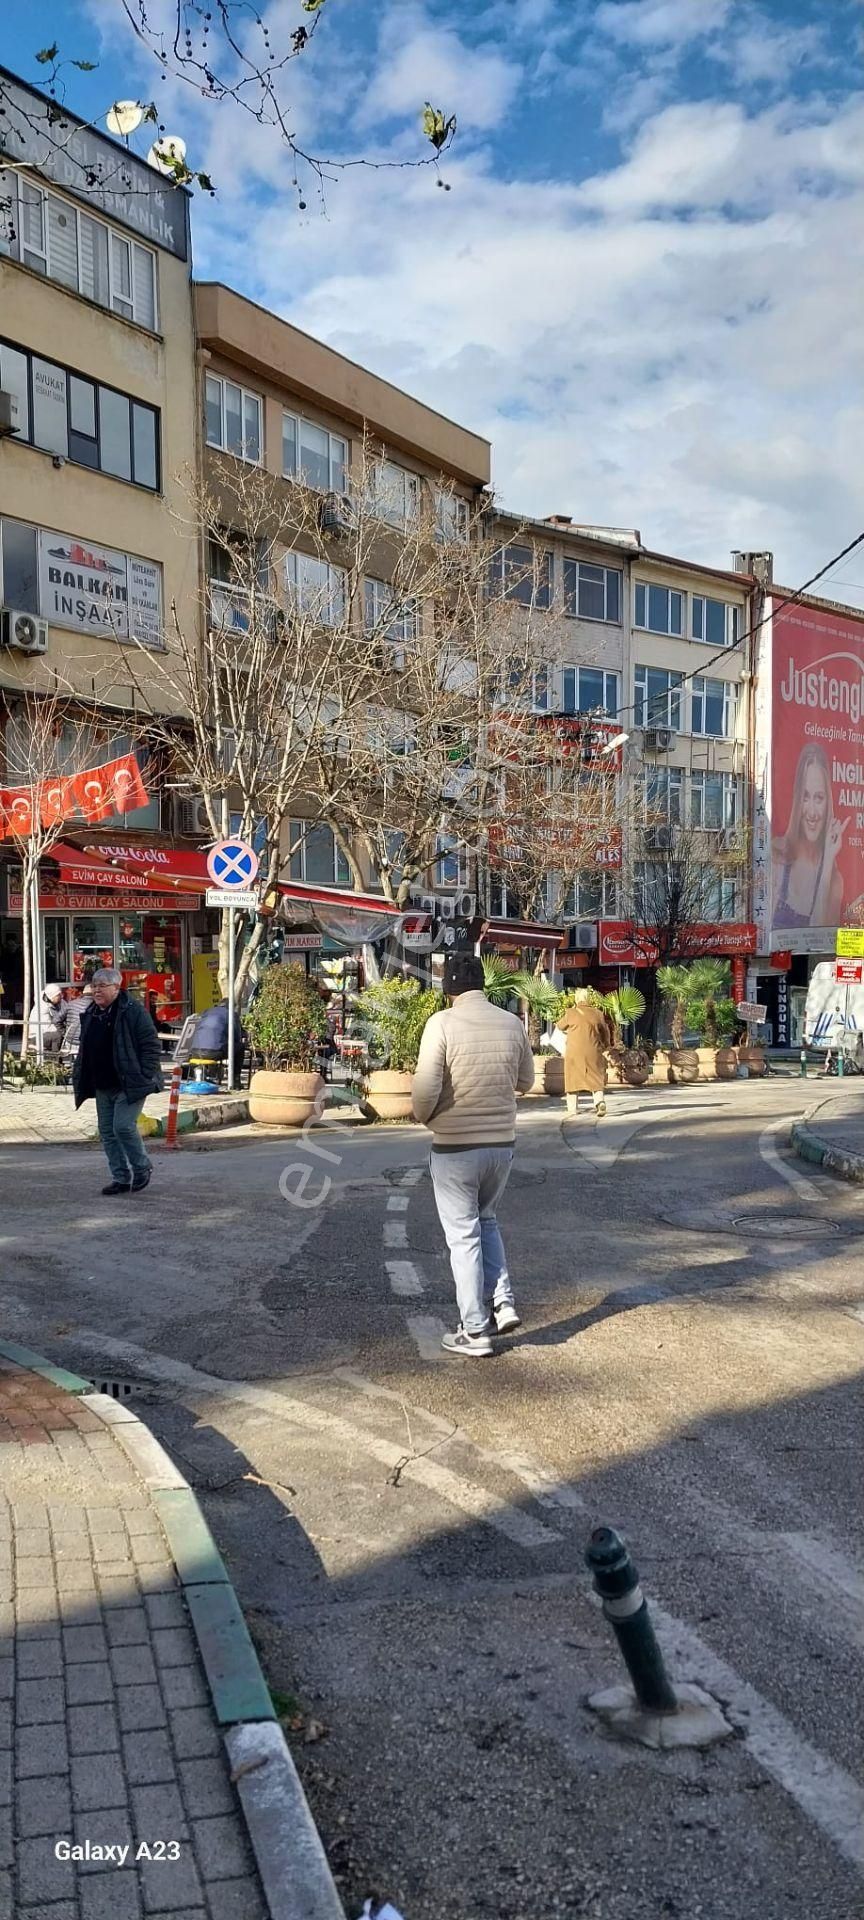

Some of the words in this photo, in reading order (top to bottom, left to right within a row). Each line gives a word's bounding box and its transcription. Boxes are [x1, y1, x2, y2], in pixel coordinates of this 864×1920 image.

[35, 372, 64, 391] AVUKAT
[54, 590, 124, 626] İNŞAAT
[72, 869, 95, 880] EVİM
[114, 874, 149, 886] SALONU
[68, 896, 97, 908] EVİM
[124, 897, 164, 908] SALONU
[777, 974, 788, 1042] KUNDURA
